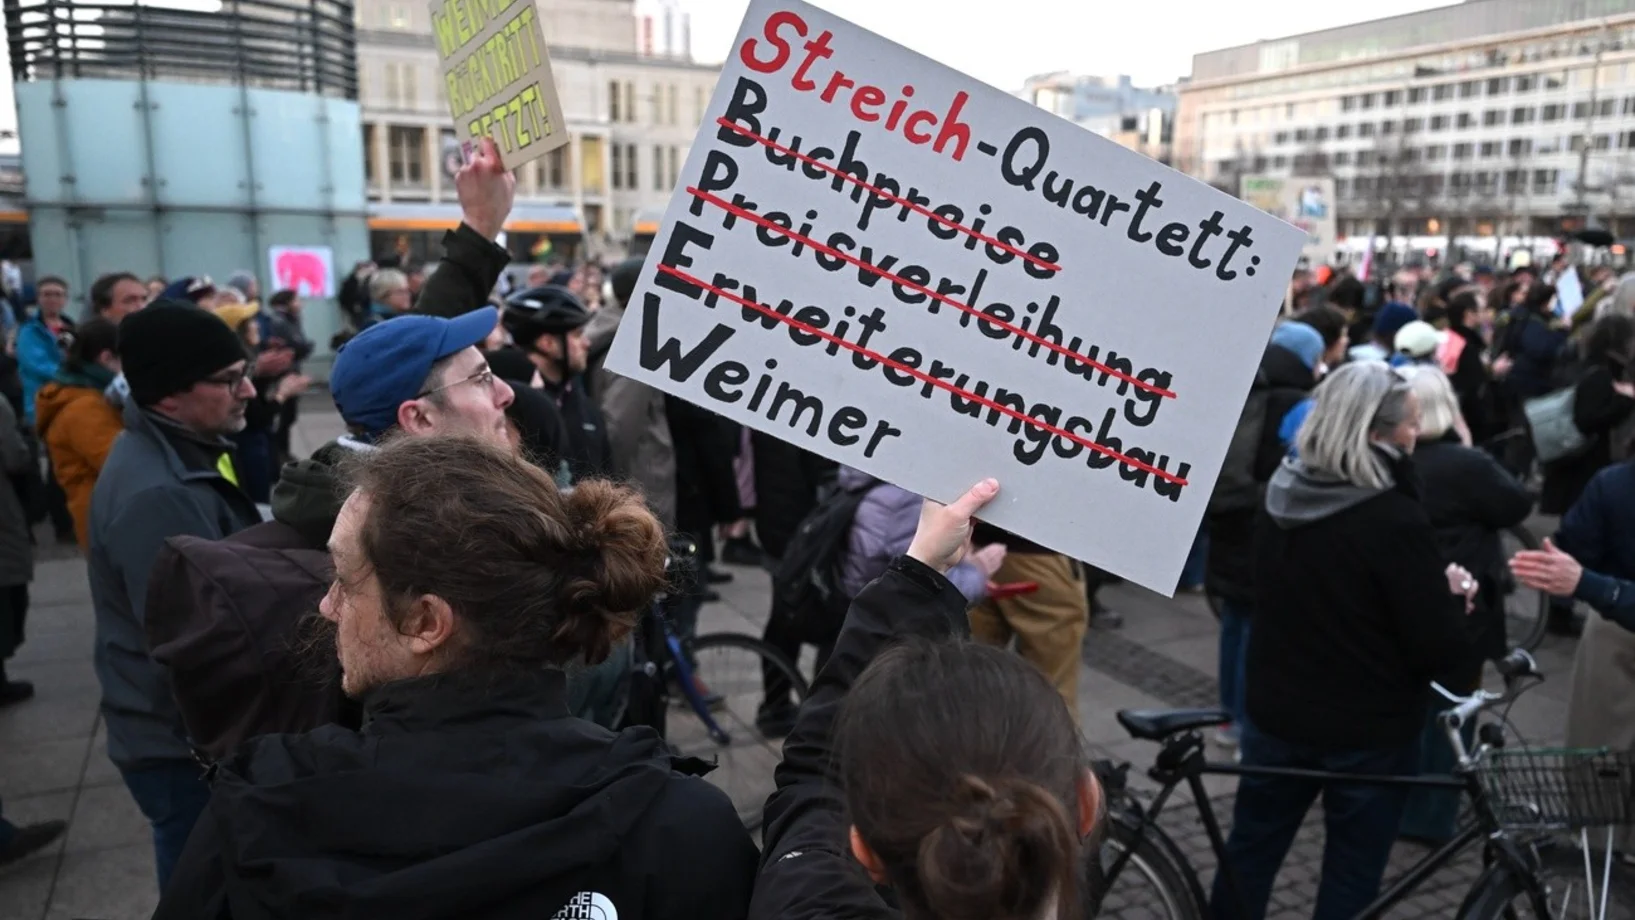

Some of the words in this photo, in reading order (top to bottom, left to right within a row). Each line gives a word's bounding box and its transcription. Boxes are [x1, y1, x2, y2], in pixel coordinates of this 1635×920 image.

[445, 5, 542, 121] RÜCKTRITT
[716, 76, 1062, 280] Buchpreise
[739, 11, 1261, 281] Streich-Quartett:
[639, 291, 902, 459] Weimer
[654, 221, 1191, 502] Erweiterungsbau
[687, 150, 1176, 427] Preisverleihung
